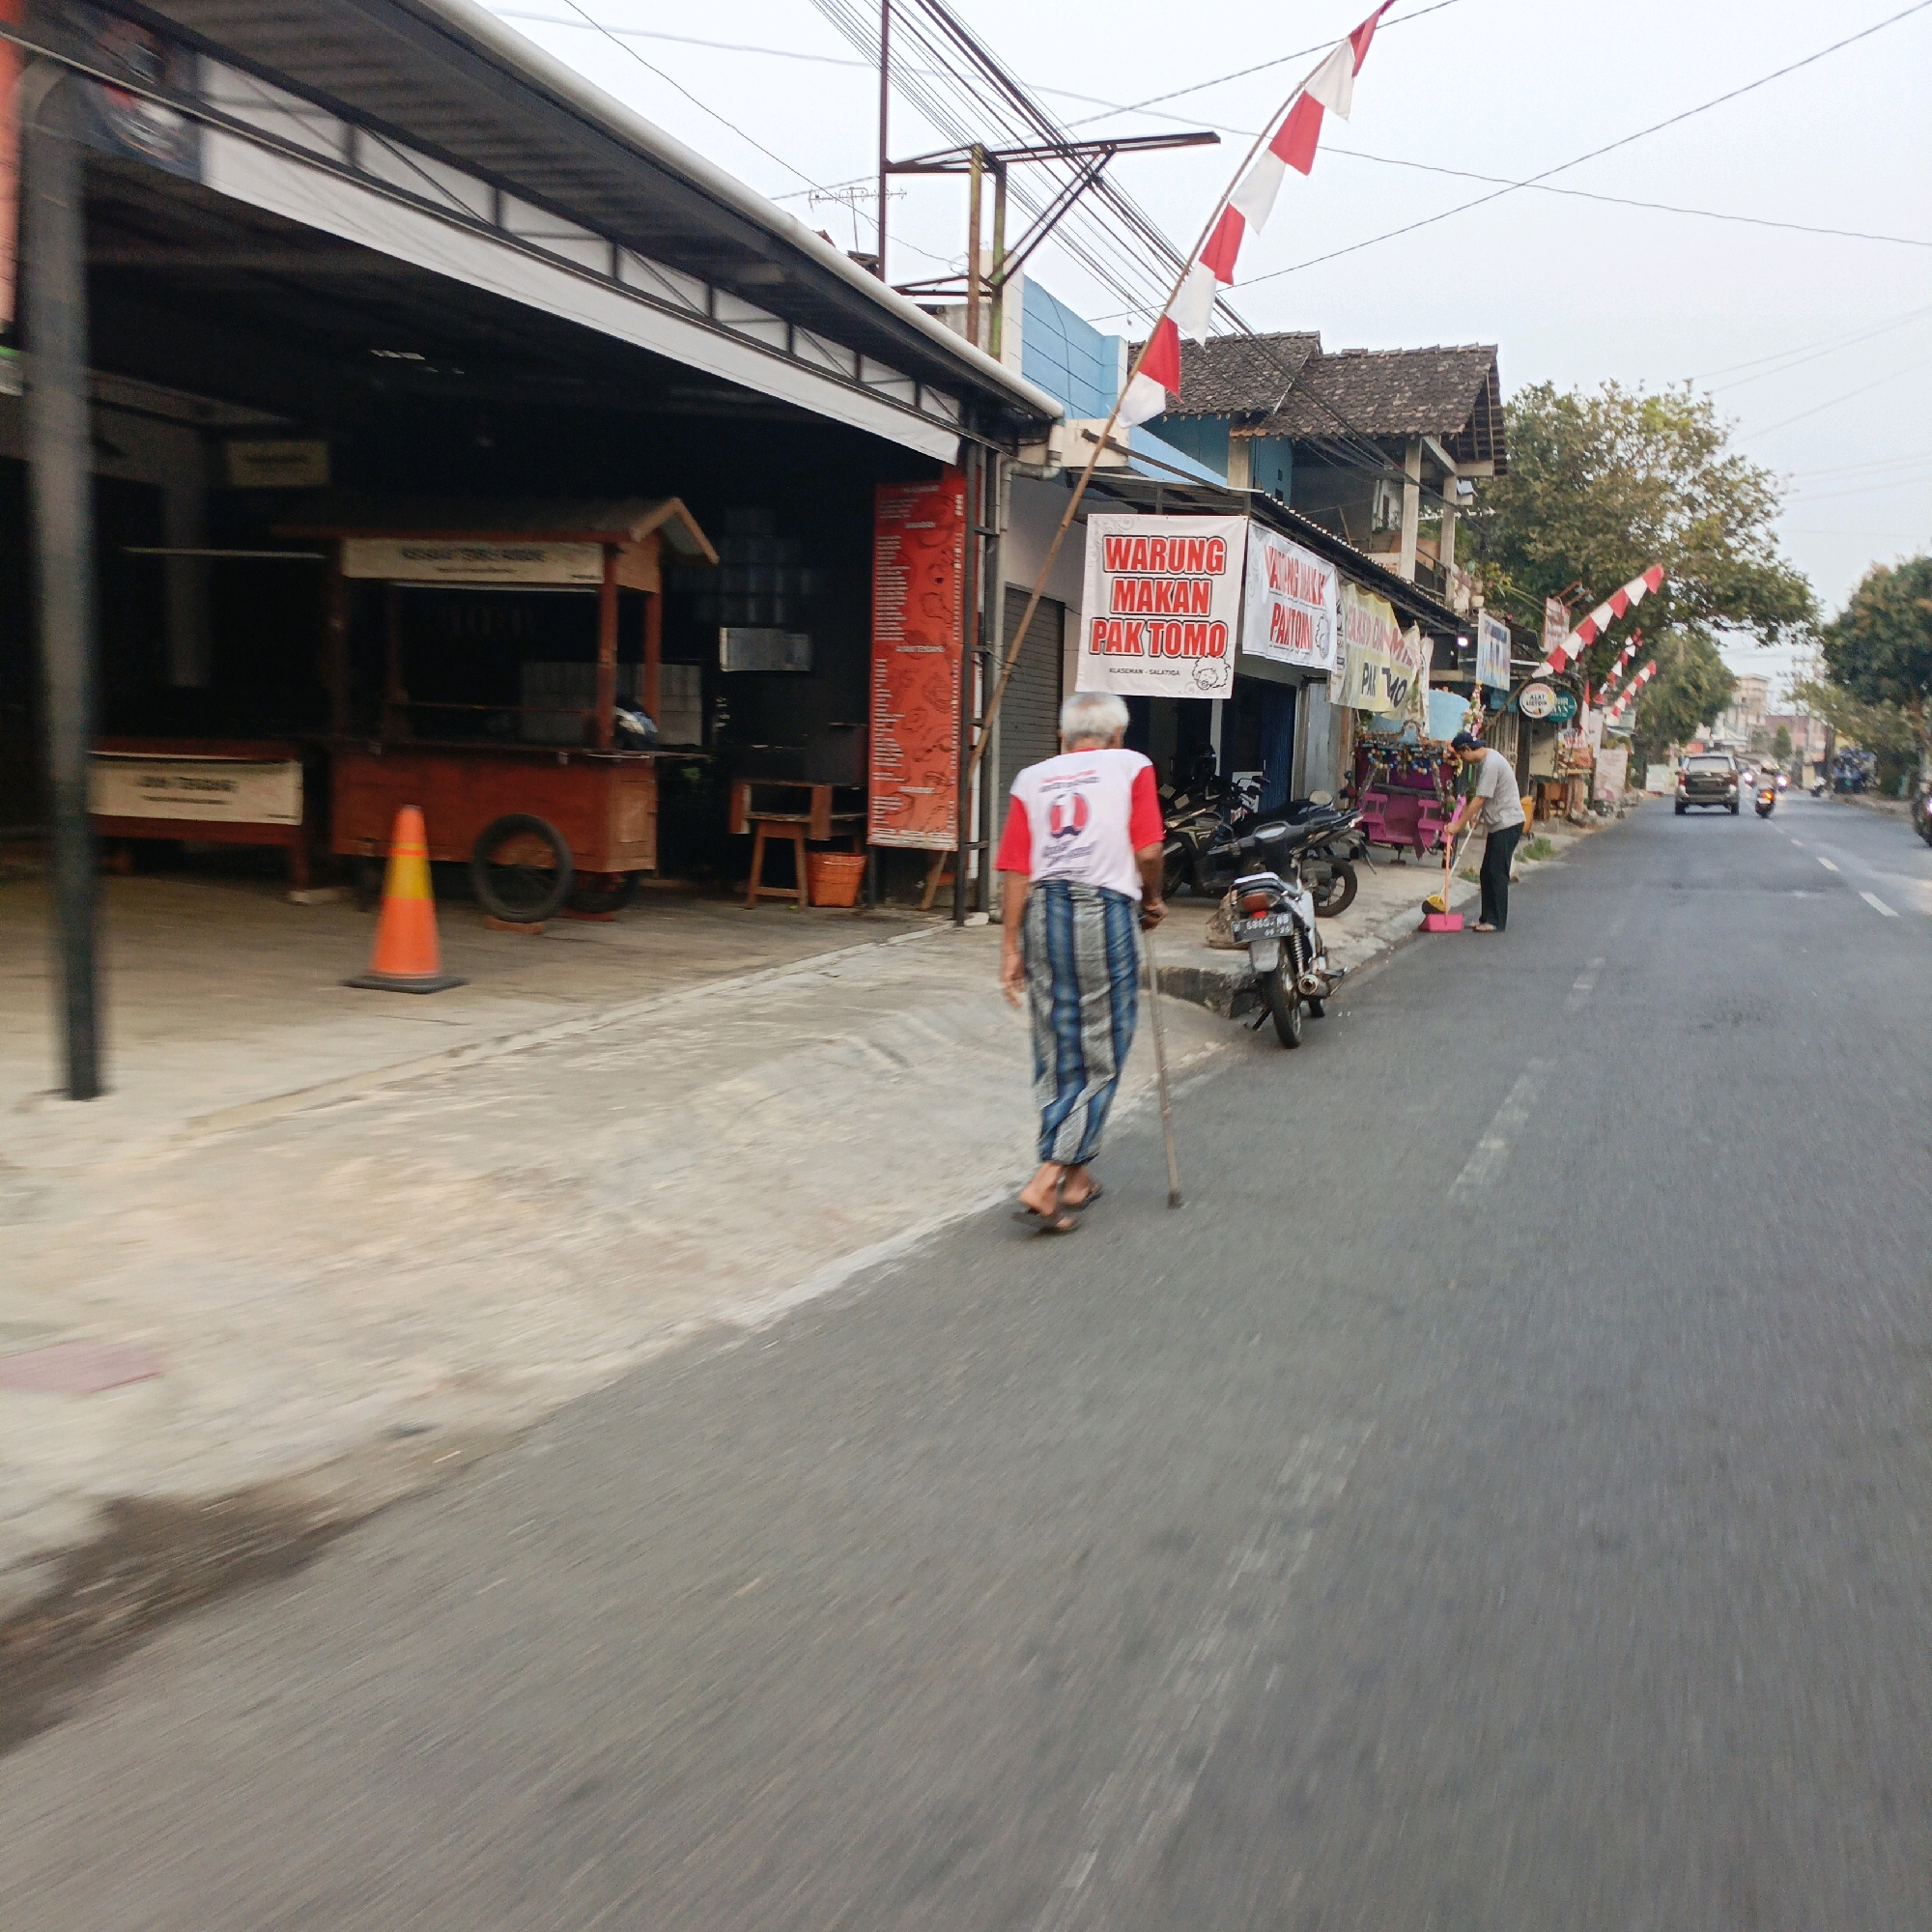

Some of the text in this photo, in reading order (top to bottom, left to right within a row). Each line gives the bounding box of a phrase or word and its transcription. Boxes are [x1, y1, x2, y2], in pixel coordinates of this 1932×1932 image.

[1104, 536, 1225, 574] WARUNG
[1111, 578, 1211, 616] MAKAN
[1090, 617, 1228, 658] PAK TOMO
